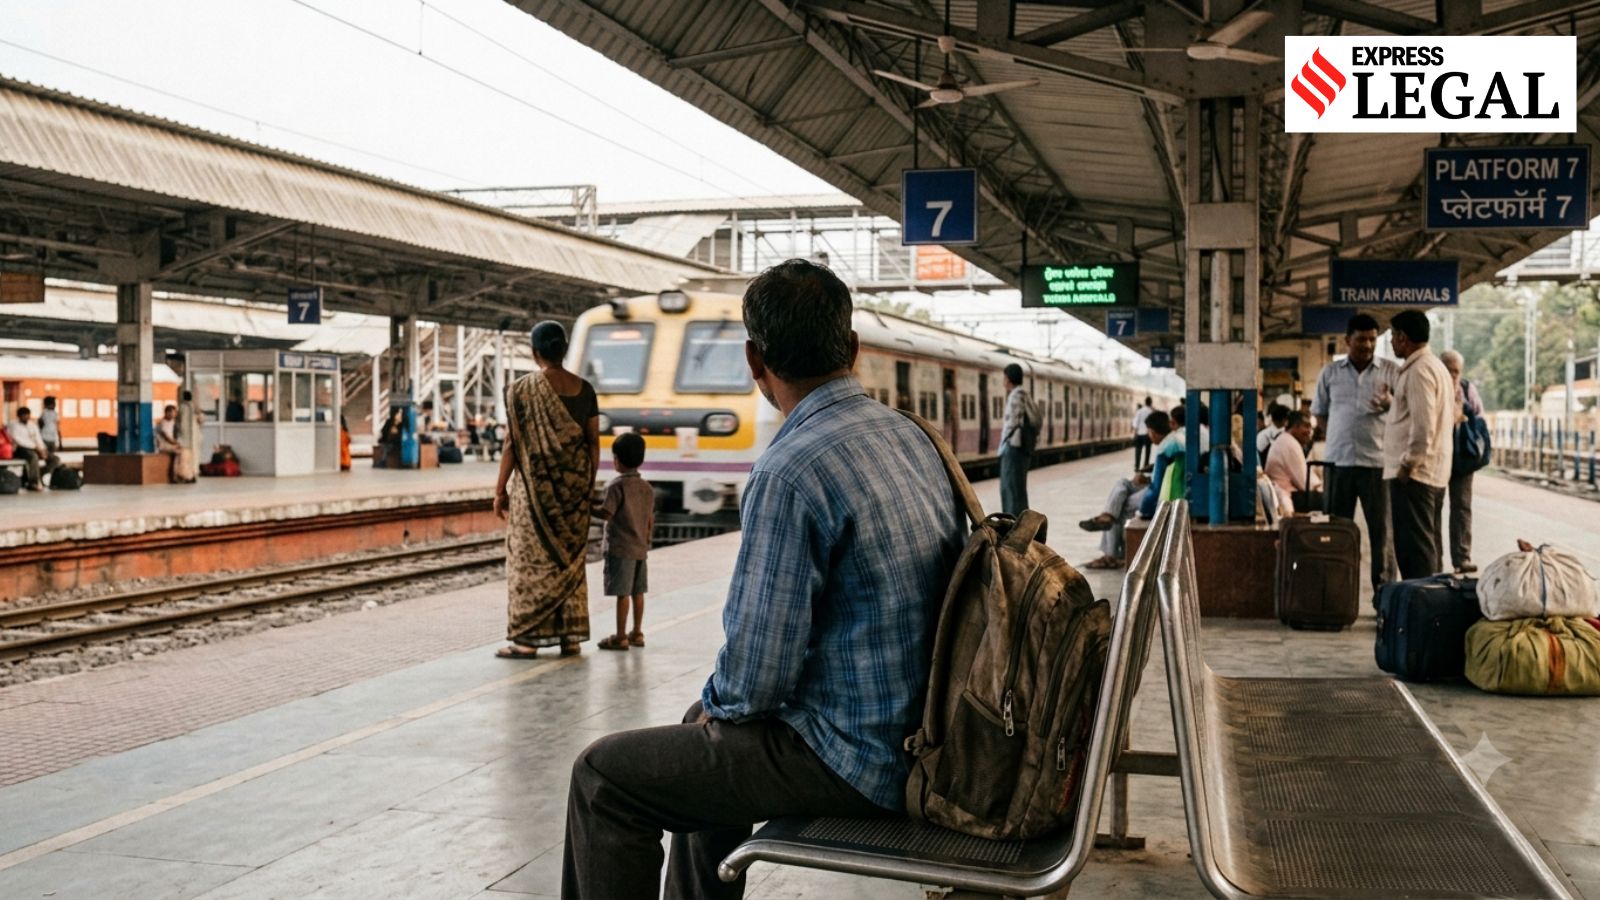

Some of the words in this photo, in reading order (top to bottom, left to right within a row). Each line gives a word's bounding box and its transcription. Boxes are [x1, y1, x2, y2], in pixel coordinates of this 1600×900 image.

[1435, 157, 1559, 181] PLATFORM
[1567, 157, 1579, 179] 7
[1441, 188, 1547, 220] प्लेटफॉर्म
[1556, 195, 1573, 219] 7
[926, 200, 953, 238] 7
[1340, 288, 1379, 302] TRAIN
[1382, 287, 1451, 302] ARRIVALS
[298, 302, 310, 322] 7
[1116, 320, 1128, 337] 7
